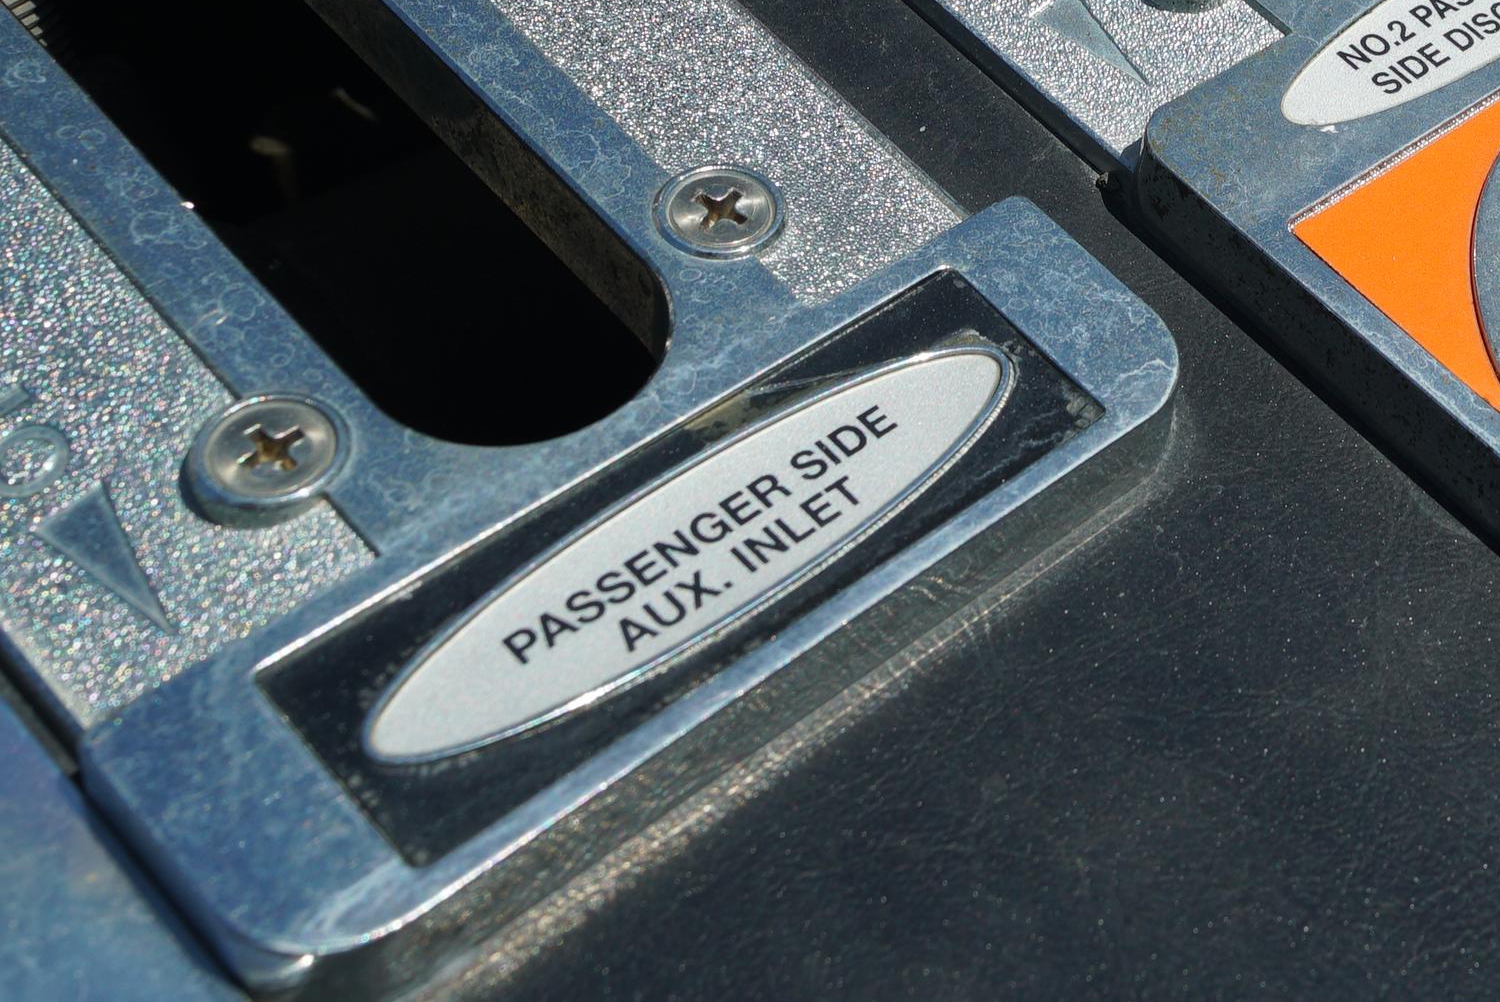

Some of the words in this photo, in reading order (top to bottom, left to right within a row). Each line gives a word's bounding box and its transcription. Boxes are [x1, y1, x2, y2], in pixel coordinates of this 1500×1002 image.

[1336, 19, 1416, 71] NO.2
[1371, 42, 1451, 95] SIDE
[502, 472, 793, 665] PASSENGER
[789, 404, 899, 481] SIDE
[617, 571, 734, 652] AUX.
[729, 475, 864, 574] INLET
